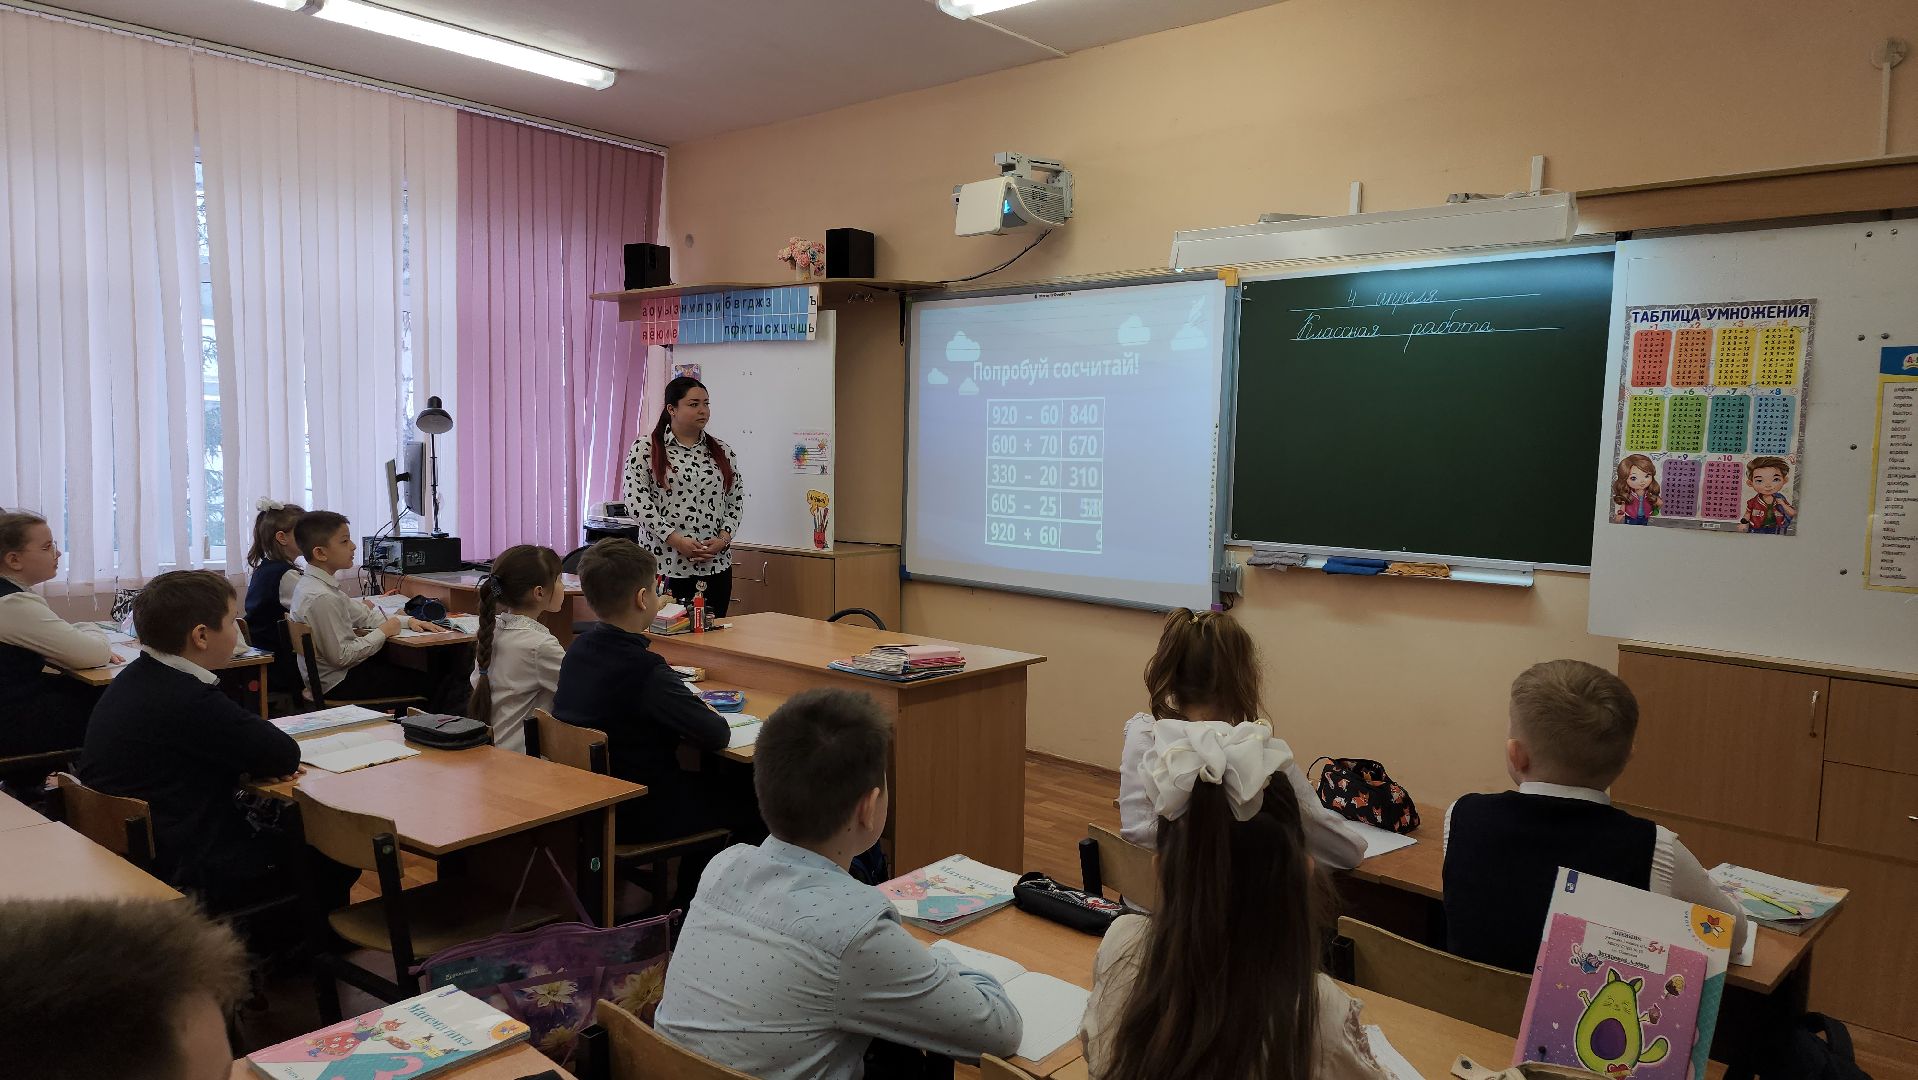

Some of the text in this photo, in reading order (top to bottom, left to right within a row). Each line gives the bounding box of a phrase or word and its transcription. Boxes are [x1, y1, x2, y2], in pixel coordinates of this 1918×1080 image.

[1347, 289, 1439, 316] 4 апреля
[1632, 304, 1810, 323] ТАБЛИЦА УМНОЖЕНИЯ
[1296, 308, 1494, 354] Классная работа
[973, 351, 1141, 386] Попробуй сосчитай!
[992, 405, 1018, 425] 920
[1040, 404, 1059, 425] 60
[1069, 403, 1098, 425] 840
[991, 434, 1017, 454] 600
[1039, 435, 1058, 455] 70
[1069, 435, 1098, 455] 670
[991, 463, 1017, 484] 330
[1039, 465, 1057, 486] 20
[1069, 466, 1098, 487] 310
[991, 493, 1016, 514] 605
[1039, 495, 1057, 516] 25
[990, 521, 1016, 542] 920
[1039, 525, 1058, 546] 60
[407, 1003, 473, 1046] Математика
